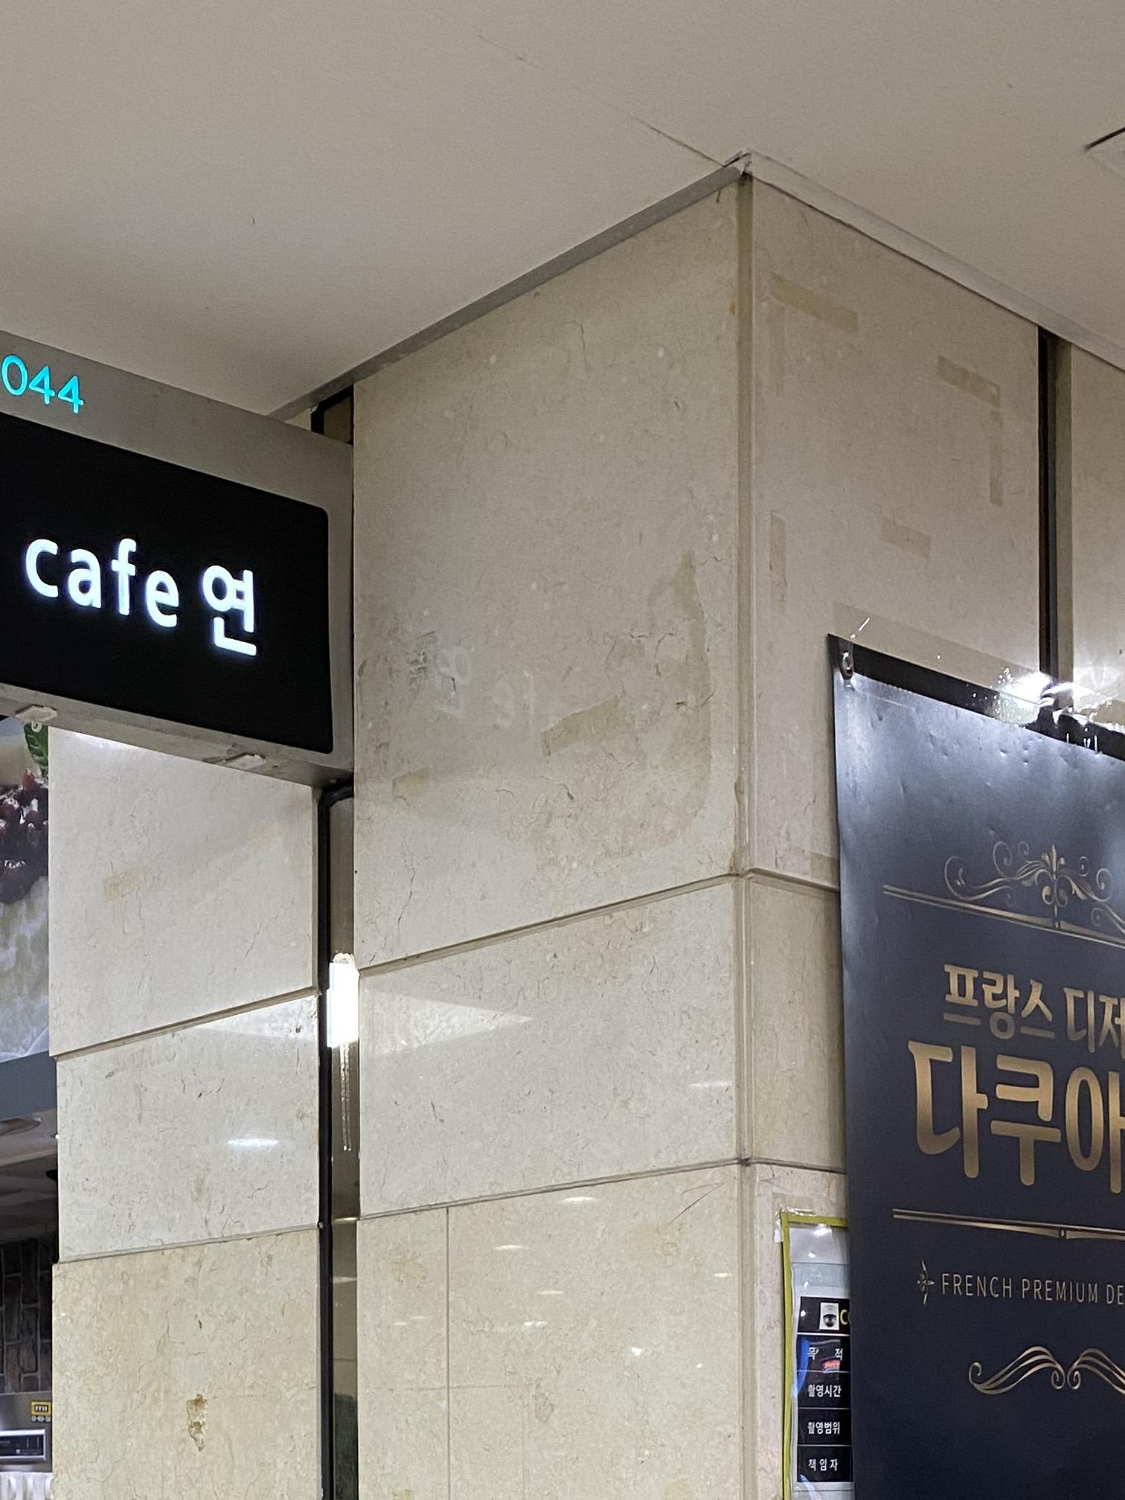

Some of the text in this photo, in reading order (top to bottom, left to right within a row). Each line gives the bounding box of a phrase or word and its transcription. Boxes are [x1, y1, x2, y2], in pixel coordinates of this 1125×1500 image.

[24, 537, 257, 656] cafe 연
[943, 963, 1055, 1039] 프랑스
[941, 1273, 1012, 1299] FRENCH
[1021, 1278, 1098, 1304] PREMIUM
[808, 1384, 842, 1398] 촬영시간
